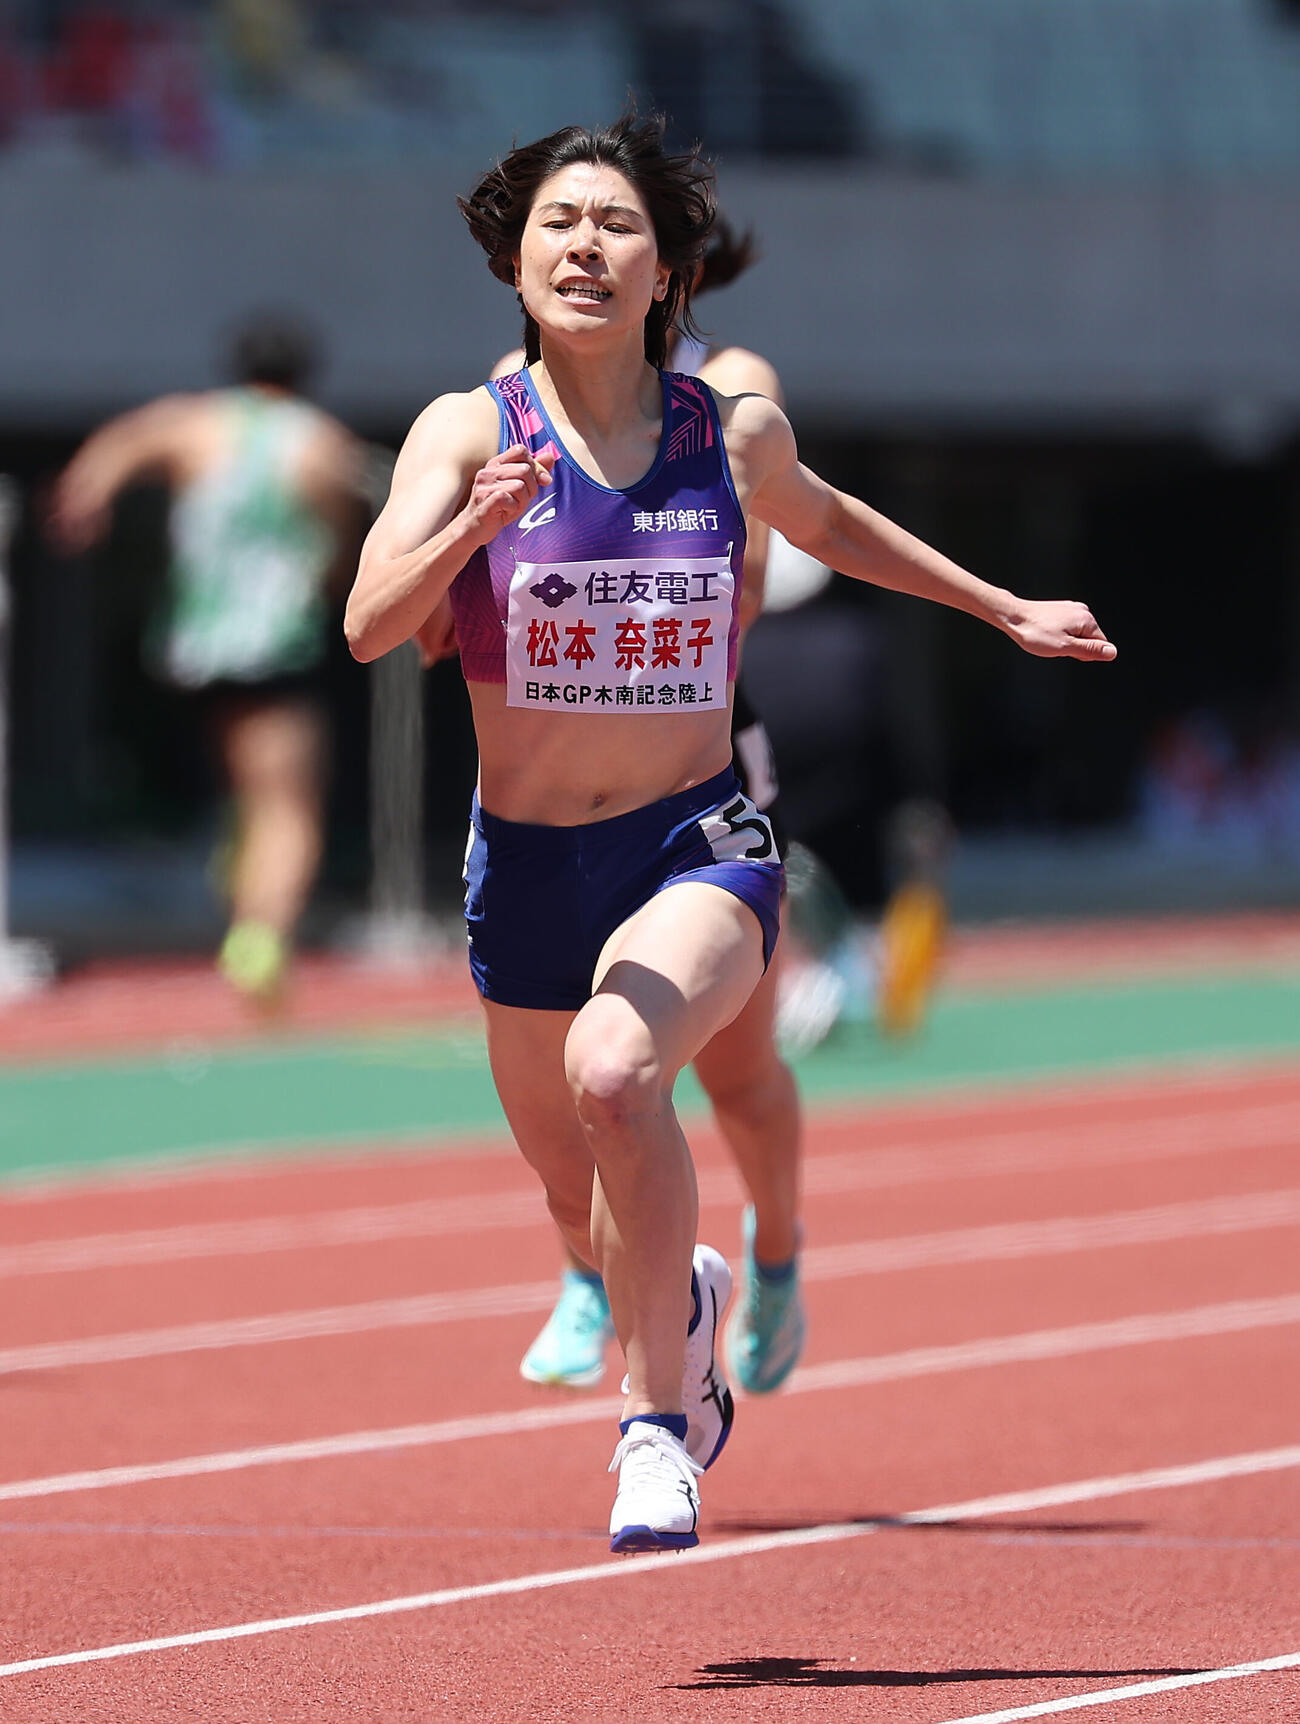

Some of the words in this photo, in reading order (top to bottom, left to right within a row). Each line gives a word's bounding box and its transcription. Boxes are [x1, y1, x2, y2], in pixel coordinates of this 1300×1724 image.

[632, 509, 719, 532] 東邦銀行
[584, 571, 719, 605] 住友電工
[526, 618, 596, 670] 松本
[614, 618, 714, 671] 奈菜子
[526, 681, 713, 706] 日本GP木南記念陸上
[722, 798, 773, 859] 5
